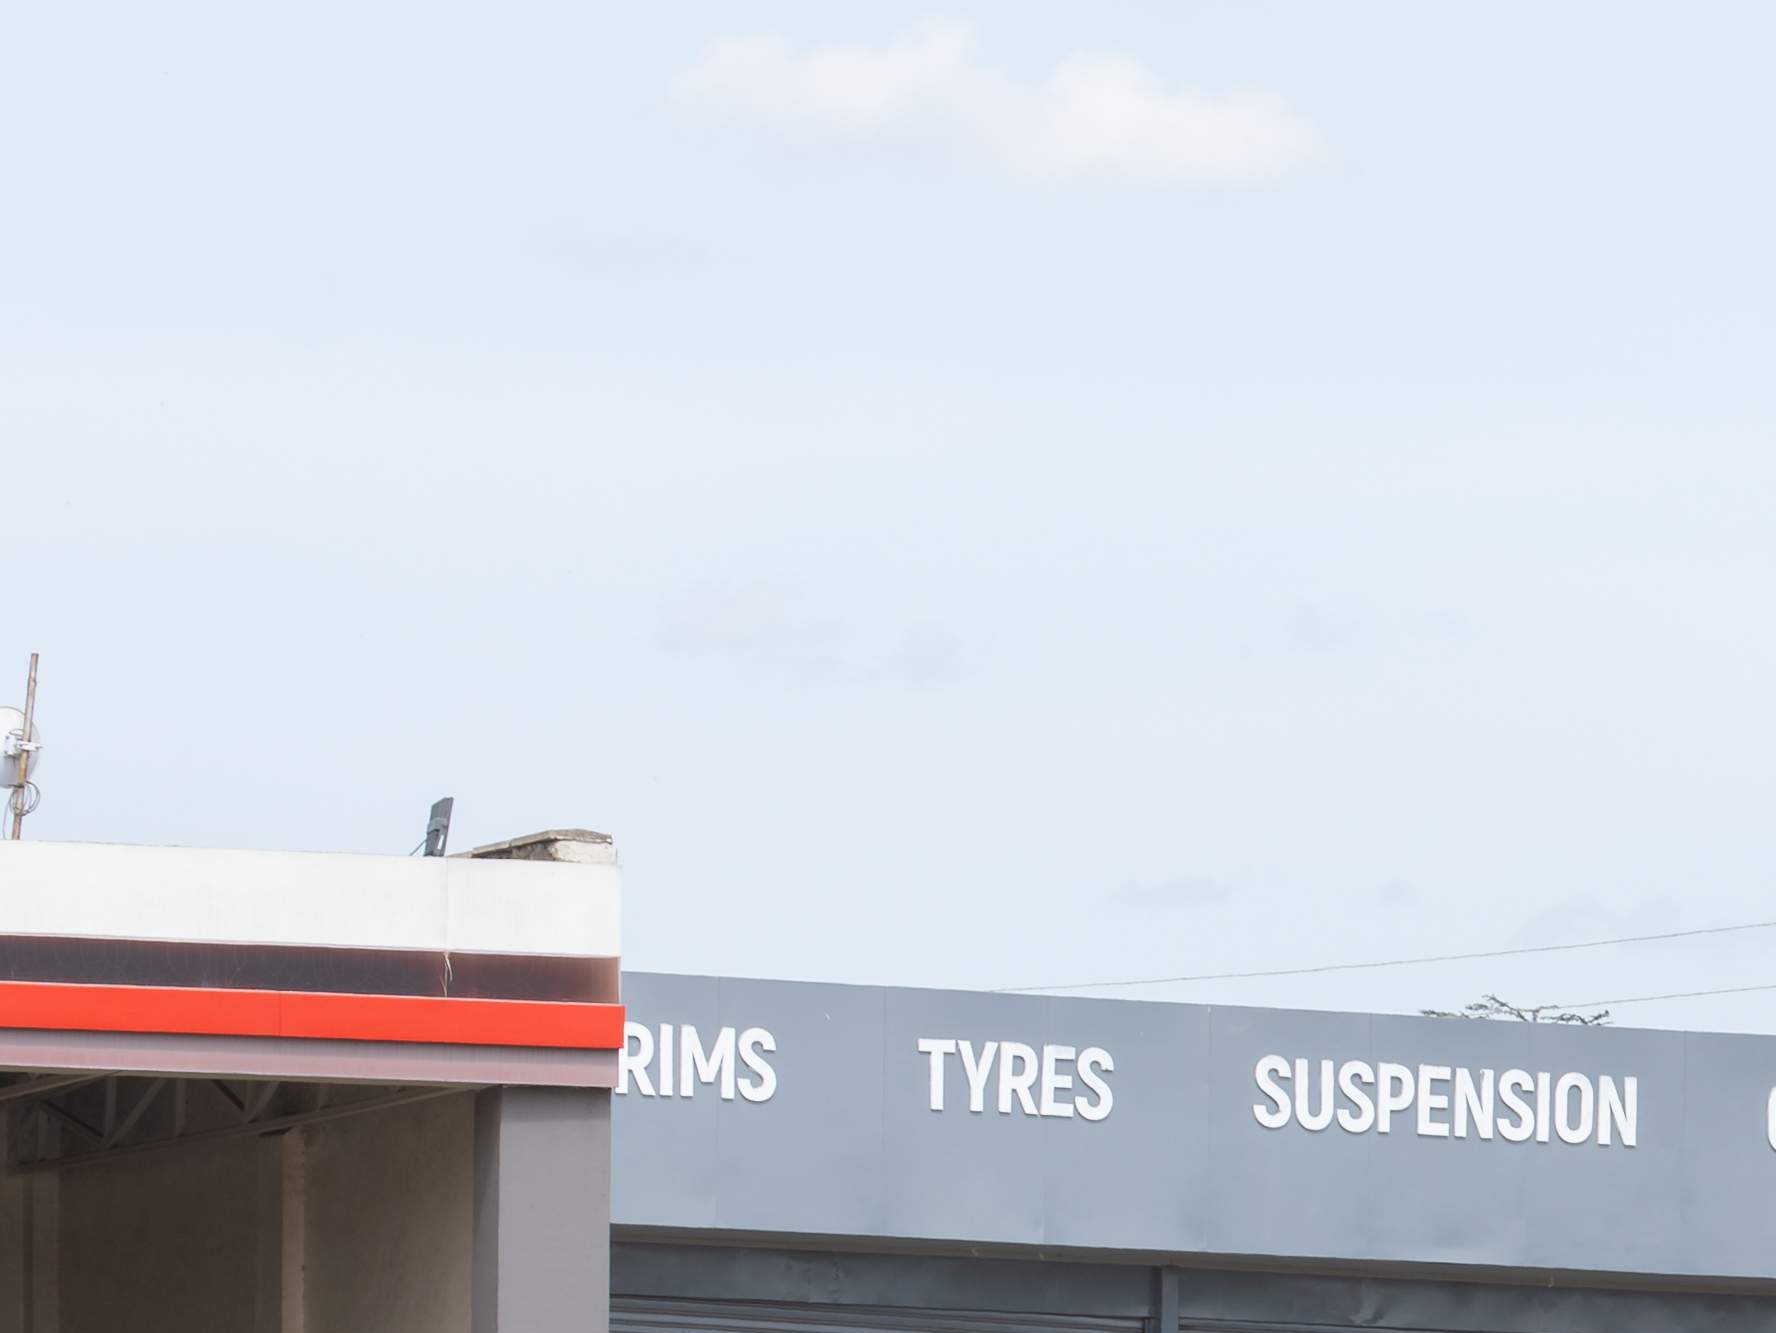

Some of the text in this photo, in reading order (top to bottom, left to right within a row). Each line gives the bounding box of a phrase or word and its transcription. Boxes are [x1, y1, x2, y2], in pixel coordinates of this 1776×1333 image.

[615, 1022, 778, 1104] RIMS
[916, 1037, 1115, 1121] TYRES
[1253, 1054, 1638, 1148] SUSPENSION
